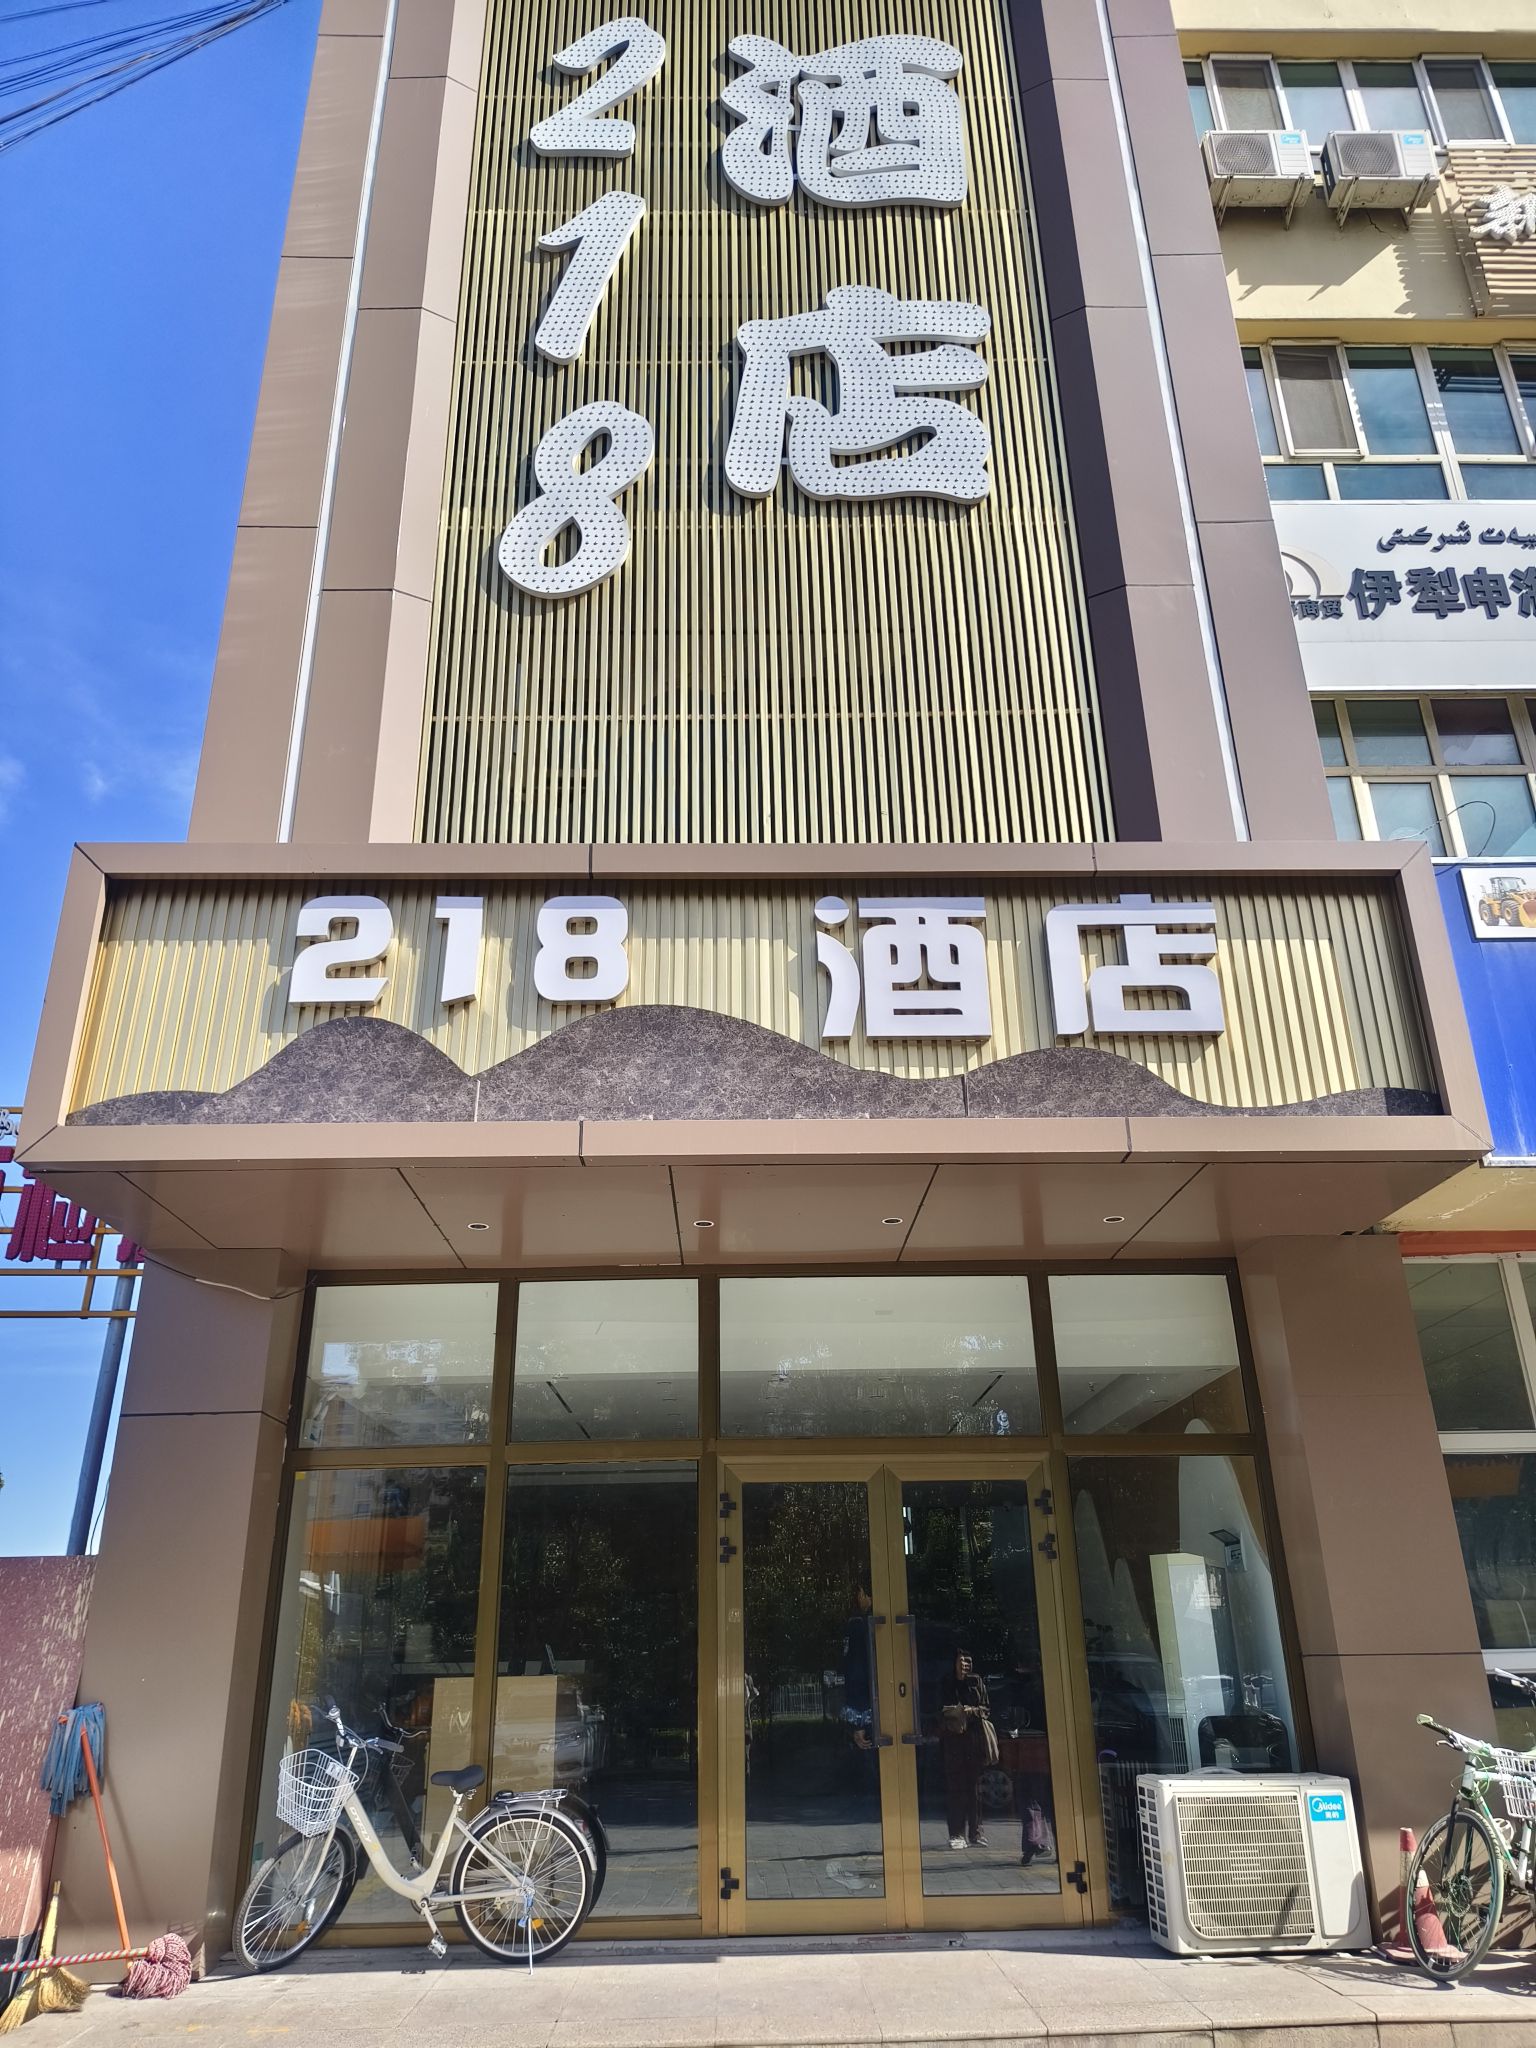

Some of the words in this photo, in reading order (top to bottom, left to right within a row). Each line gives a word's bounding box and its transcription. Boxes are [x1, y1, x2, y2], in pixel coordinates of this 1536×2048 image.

[498, 17, 666, 599] 218
[720, 34, 991, 505] 酒店
[1291, 599, 1343, 620] 商贸
[288, 895, 630, 1006] 218
[814, 893, 1225, 1043] 酒店
[1311, 1797, 1342, 1812] Midea
